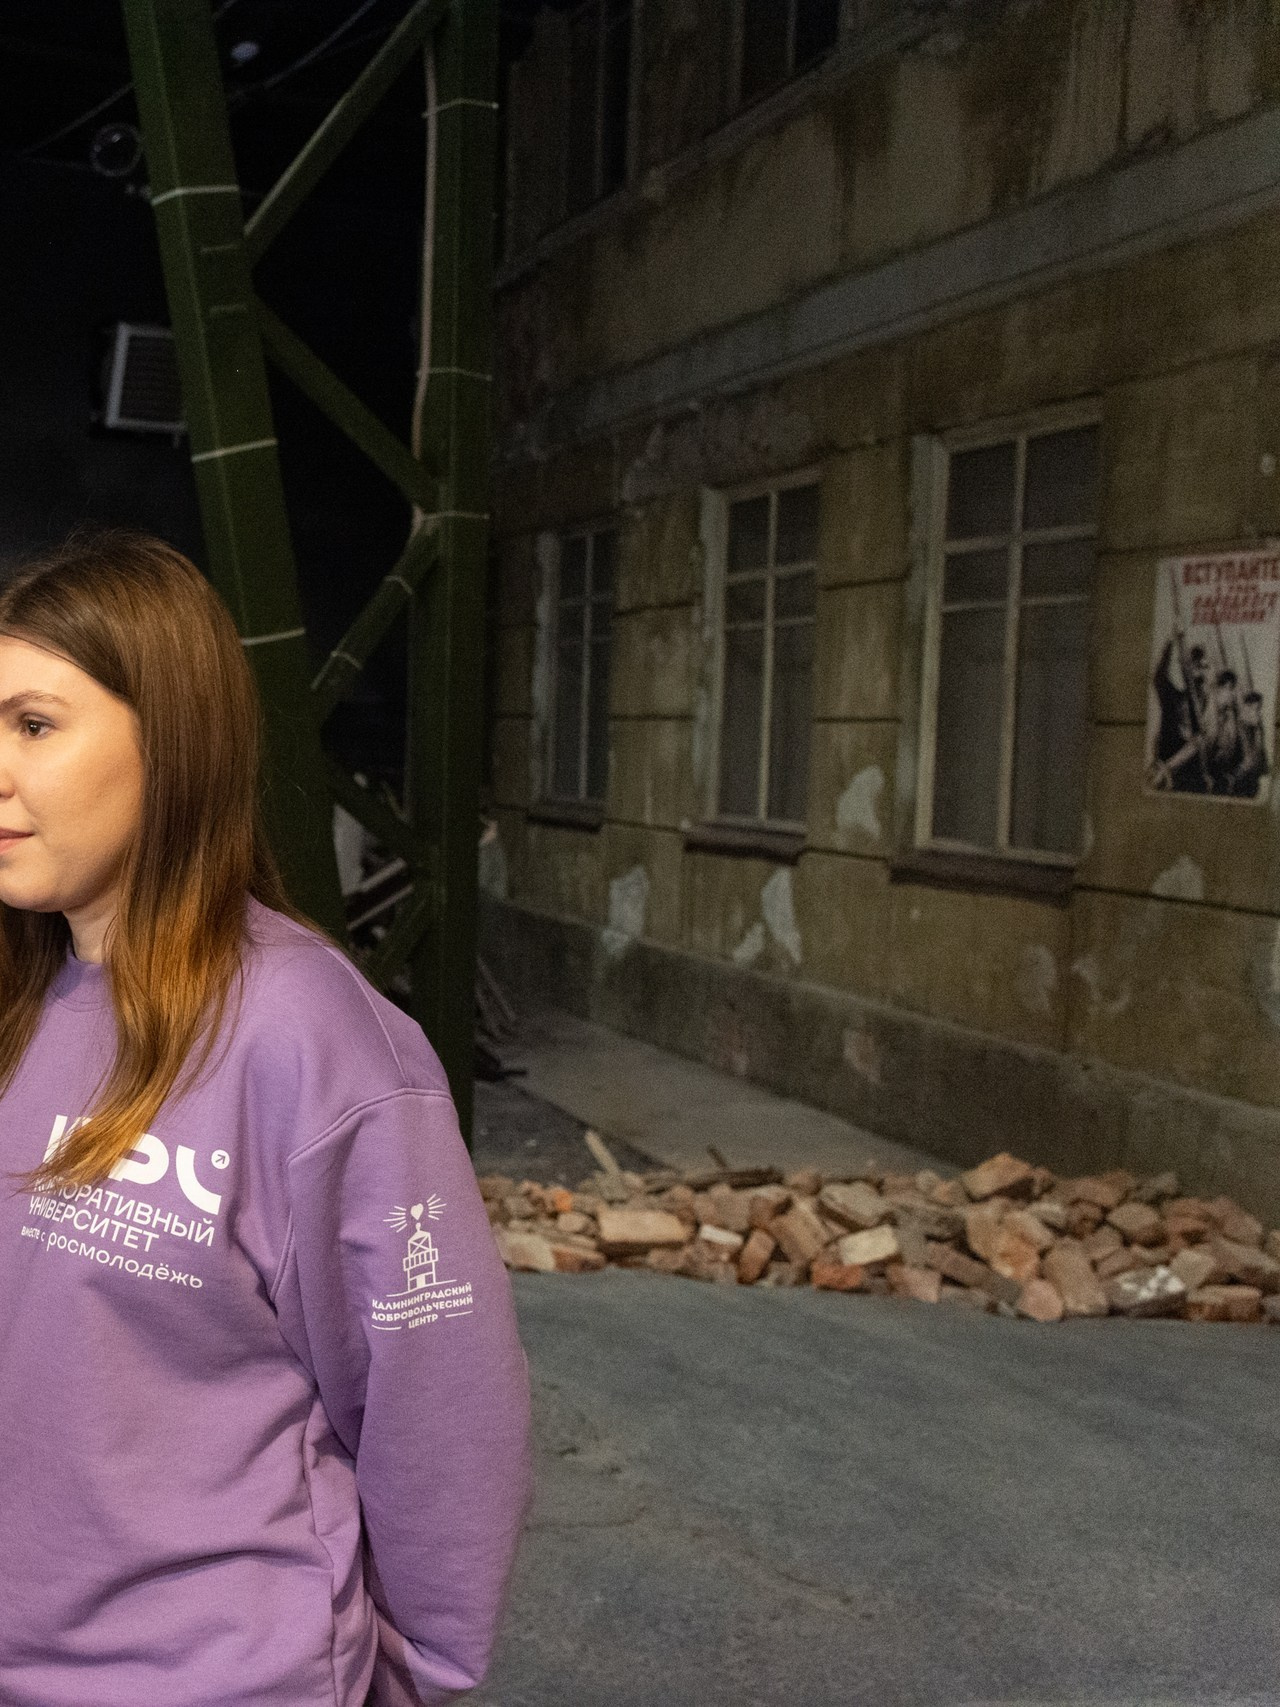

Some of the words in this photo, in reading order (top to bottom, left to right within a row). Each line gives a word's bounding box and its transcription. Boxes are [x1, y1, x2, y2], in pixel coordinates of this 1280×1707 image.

[28, 1195, 160, 1253] УНИВЕРСИТЕТ
[41, 1232, 46, 1242] с
[47, 1232, 204, 1289] росмолодёжь
[371, 1296, 473, 1322] ДОБРОВОЛЬЧЕСКИЙ
[372, 1282, 472, 1311] КАЛИНИНГРАДСКИЙ
[408, 1313, 438, 1329] ЦЕНТР
